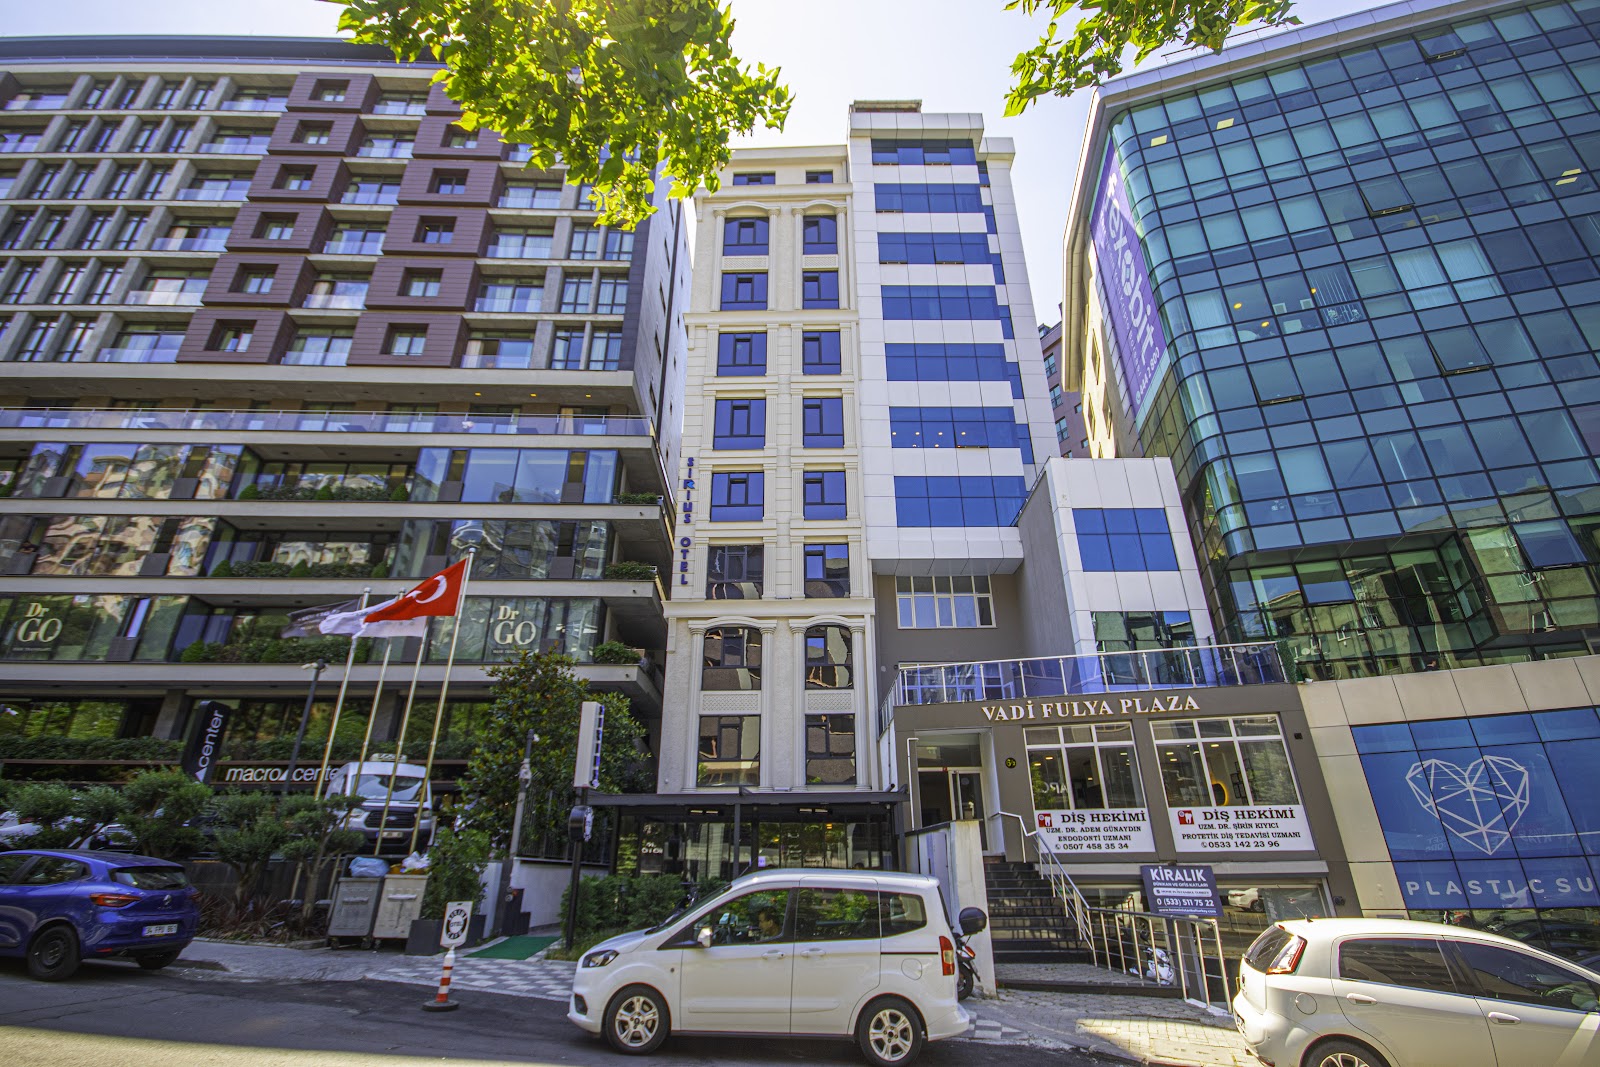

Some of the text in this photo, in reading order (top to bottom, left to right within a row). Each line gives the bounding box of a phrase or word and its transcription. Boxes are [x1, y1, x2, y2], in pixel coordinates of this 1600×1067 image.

[680, 457, 695, 585] SIRIUS OTEL
[25, 602, 50, 617] Dr
[497, 605, 520, 620] Dr
[17, 618, 63, 642] GO
[494, 620, 537, 645] GO
[982, 695, 1200, 721] VADİ FULYA PLAZA
[198, 710, 224, 768] center
[225, 767, 280, 782] macro
[1061, 810, 1147, 825] DİŞ HEKİMİ
[1202, 807, 1296, 822] DİŞ HEKİMİ
[1221, 832, 1234, 840] DİŞ
[1150, 866, 1207, 881] KİRALIK
[1406, 879, 1545, 895] PLASTIC
[1163, 898, 1181, 906] (533)
